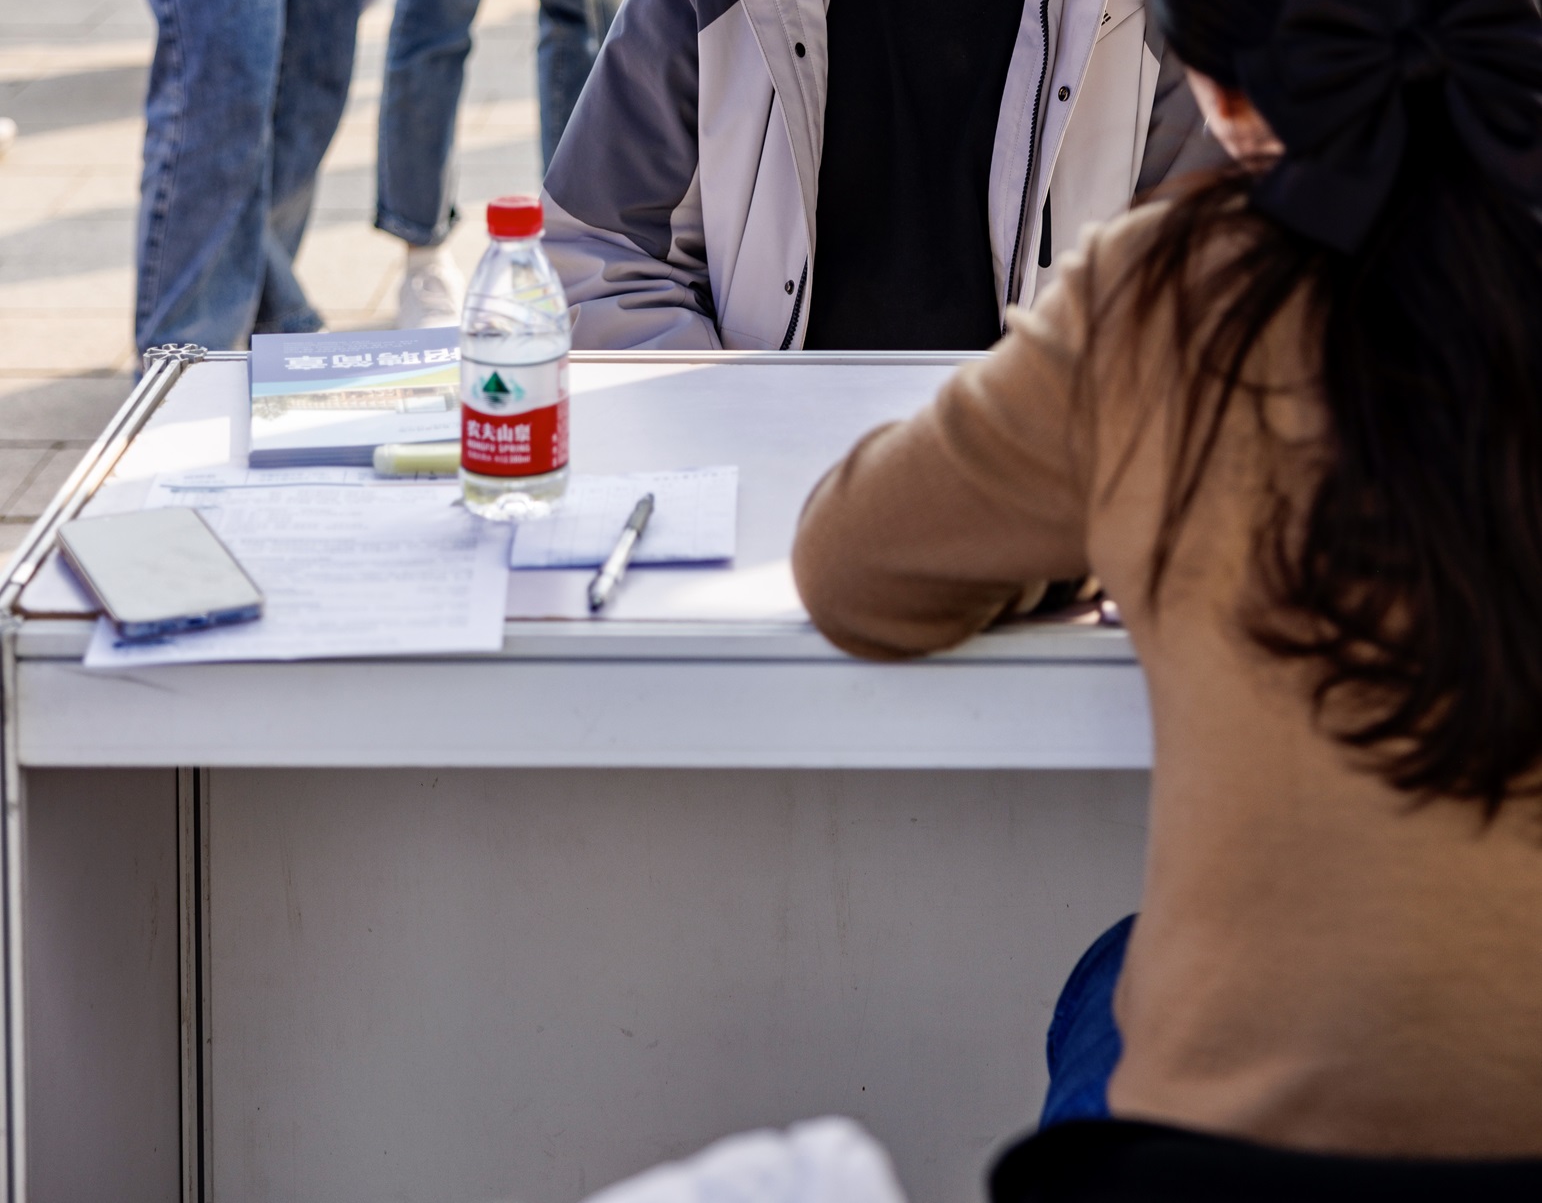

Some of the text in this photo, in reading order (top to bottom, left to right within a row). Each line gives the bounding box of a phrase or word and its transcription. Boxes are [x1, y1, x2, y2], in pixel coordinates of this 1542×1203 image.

[285, 347, 460, 370] 招聘简章
[467, 419, 531, 443] 农夫山泉
